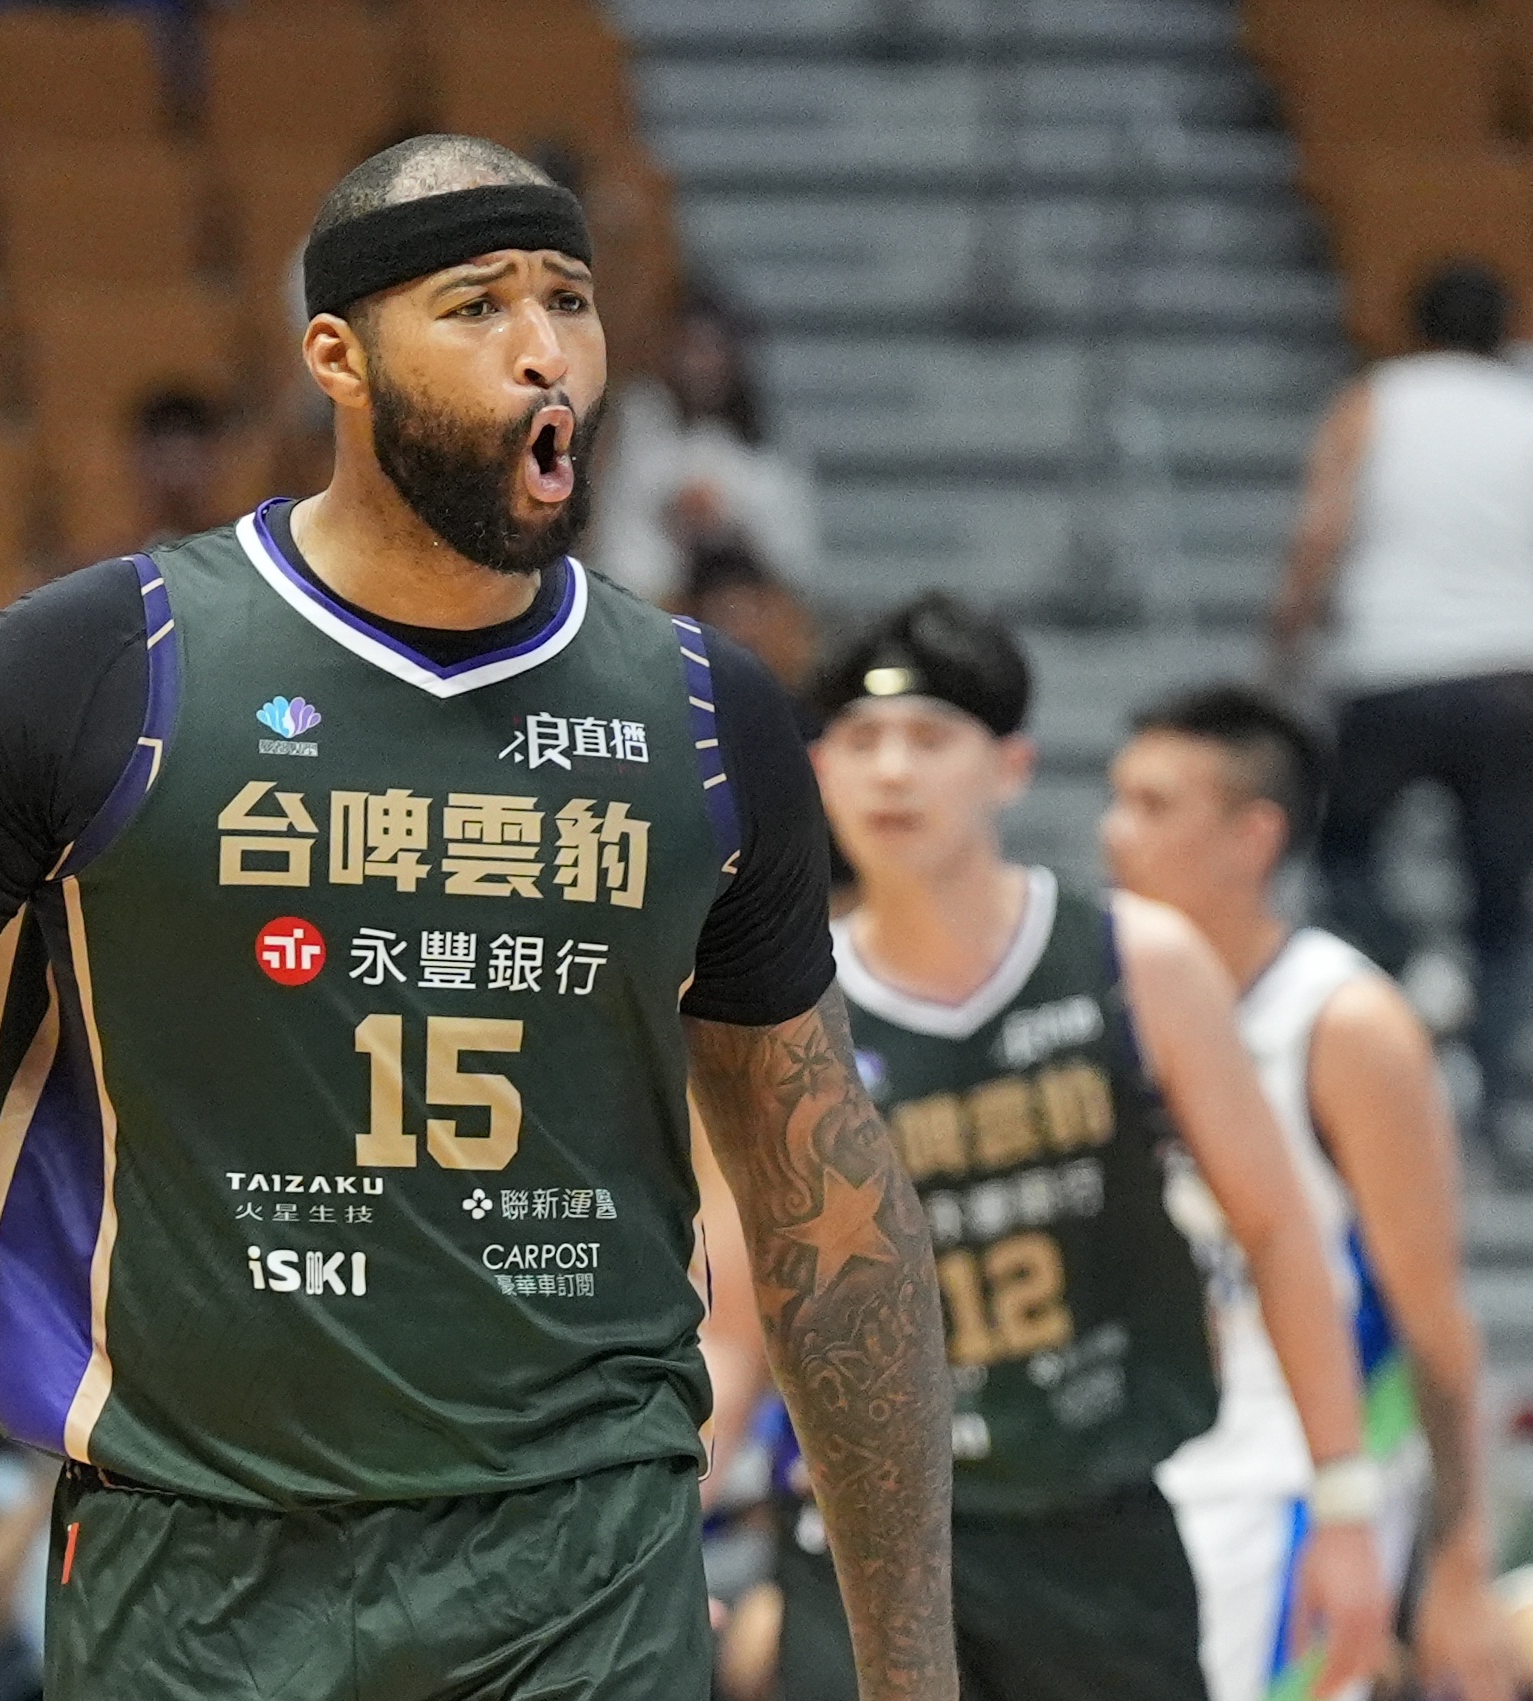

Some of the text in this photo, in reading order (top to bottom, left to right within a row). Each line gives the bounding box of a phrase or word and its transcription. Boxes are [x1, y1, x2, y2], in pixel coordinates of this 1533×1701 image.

[498, 711, 649, 771] 浪直播
[217, 780, 651, 909] 台啤雲豹
[348, 927, 609, 996] 永豐銀行
[354, 1013, 524, 1171] 15
[225, 1172, 384, 1195] TAIZAKU
[235, 1201, 374, 1224] 火星生技
[247, 1245, 367, 1297] iSKI
[482, 1242, 601, 1270] CARPOST
[494, 1272, 595, 1298] 豪華車訂閱
[935, 1229, 1074, 1366] 12
